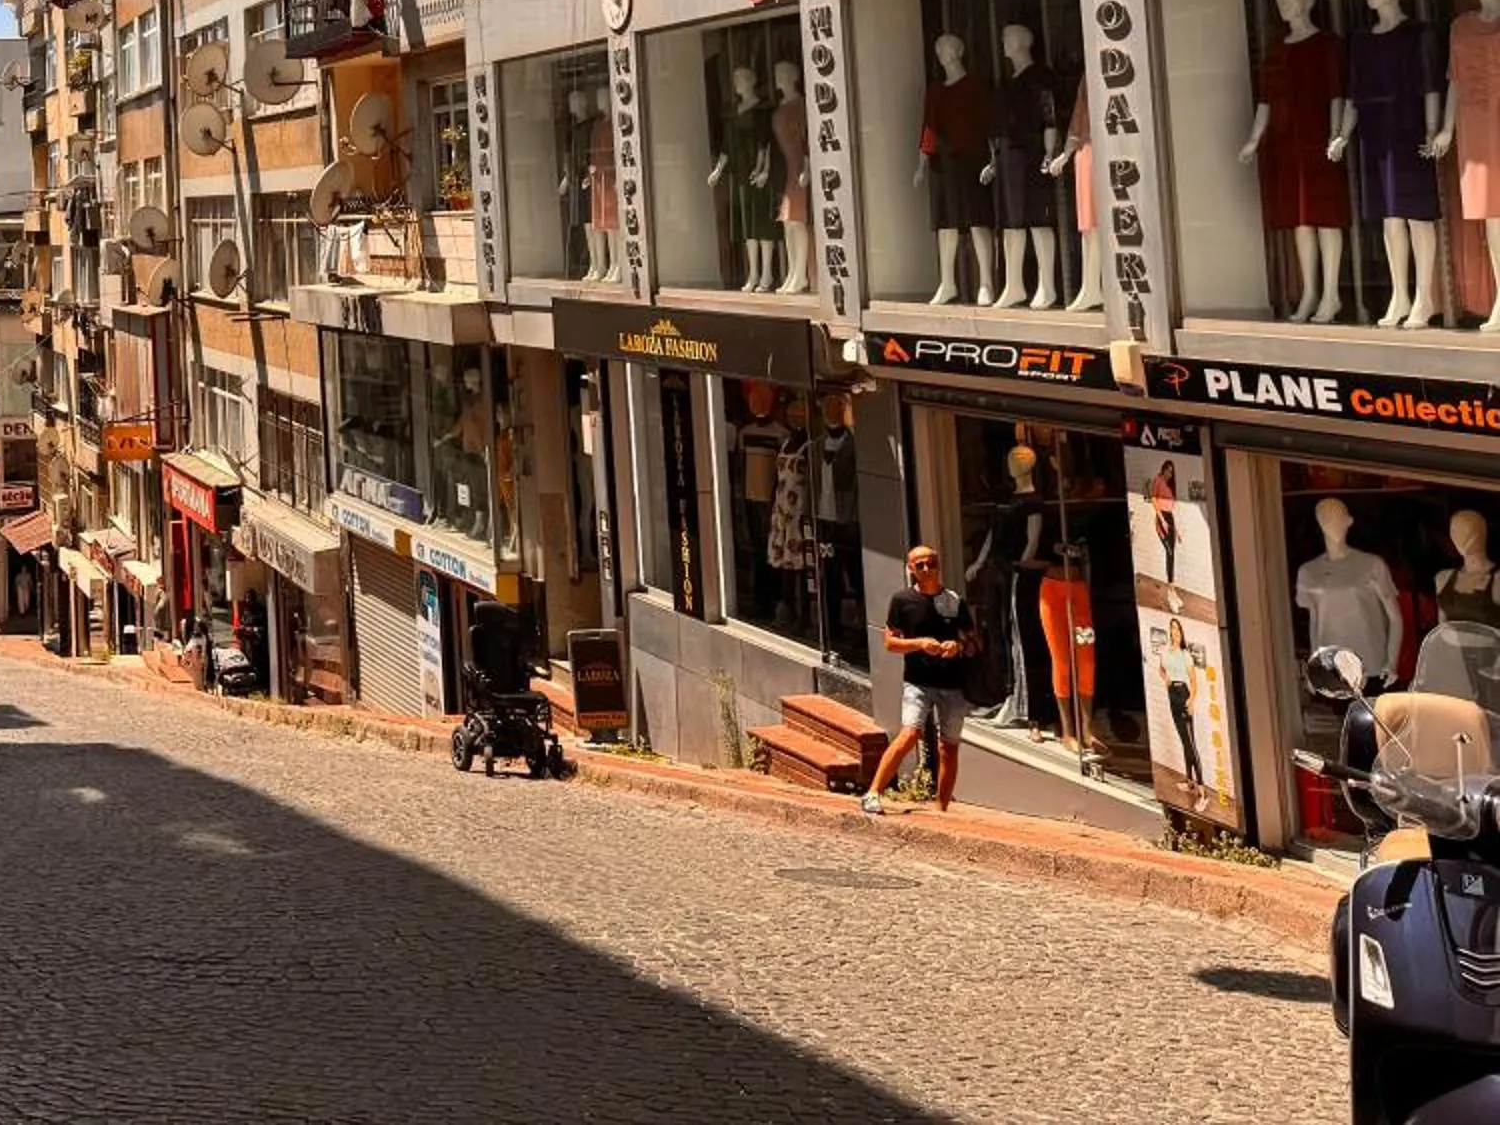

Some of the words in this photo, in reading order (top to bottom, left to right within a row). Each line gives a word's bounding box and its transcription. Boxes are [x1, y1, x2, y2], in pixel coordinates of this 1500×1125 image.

[809, 4, 842, 153] MODA
[613, 46, 637, 168] MODA
[665, 337, 718, 363] FASHION
[915, 339, 1096, 380] PROFIT
[1203, 367, 1344, 413] PLANE
